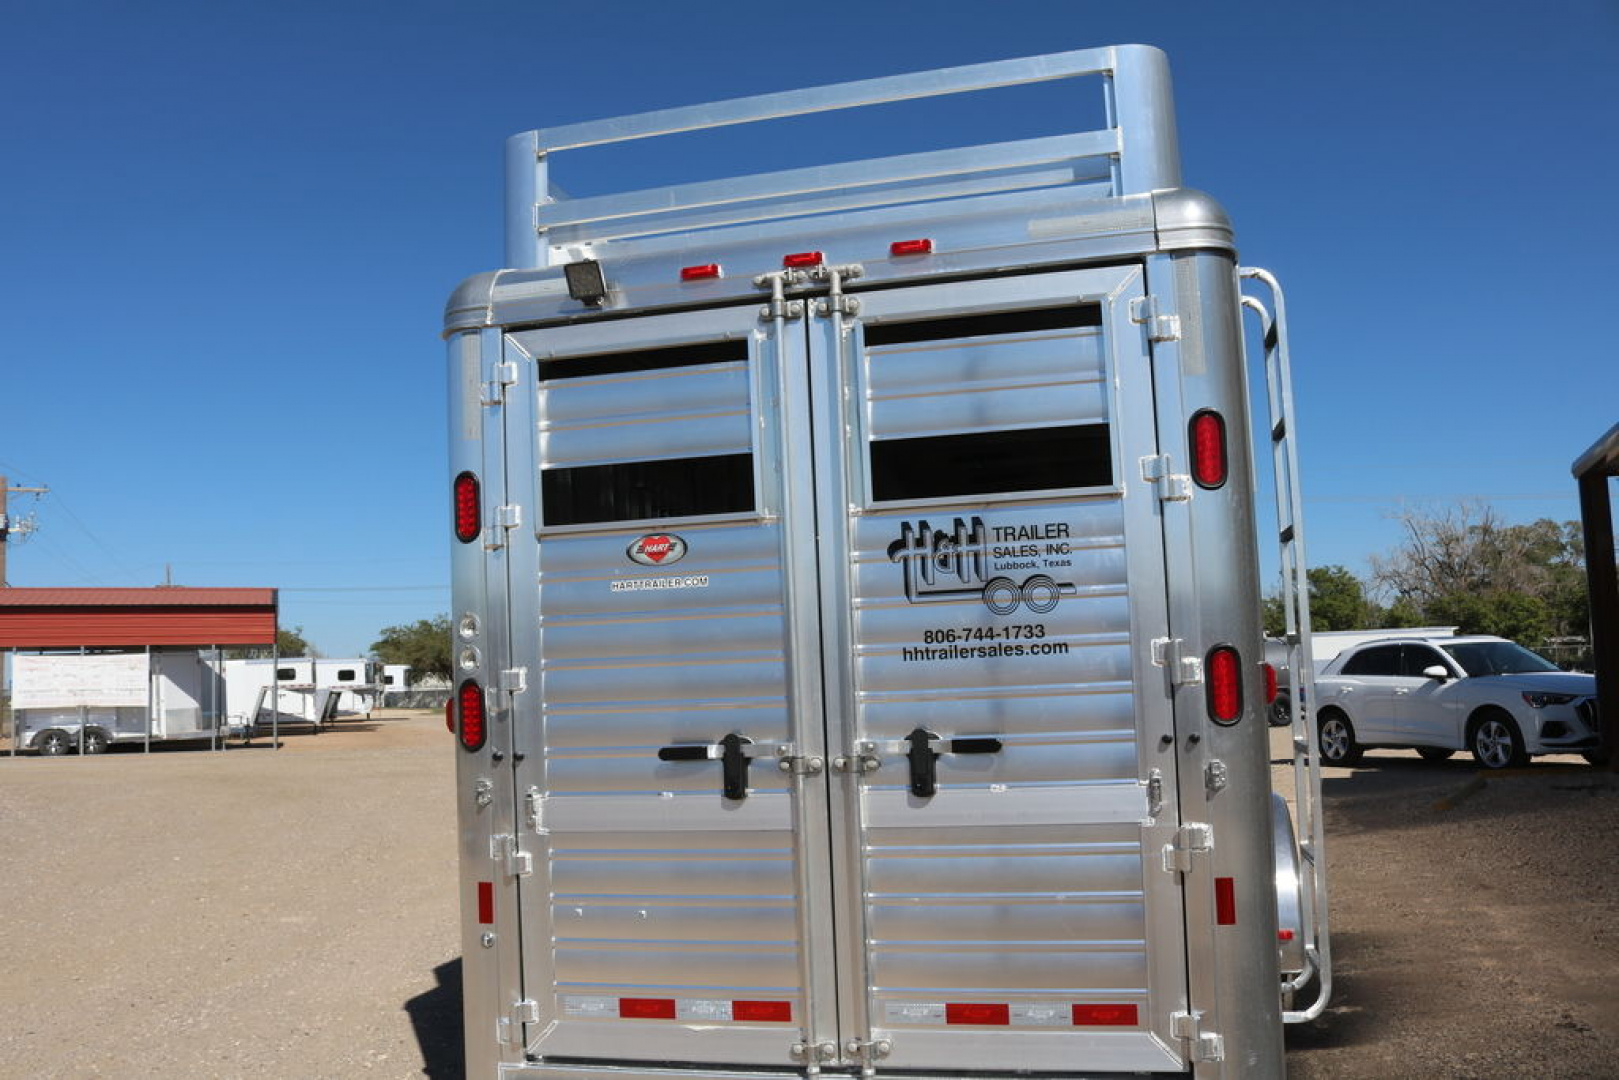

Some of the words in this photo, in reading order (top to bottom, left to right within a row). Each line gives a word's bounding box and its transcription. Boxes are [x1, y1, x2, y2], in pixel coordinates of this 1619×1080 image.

[992, 523, 1070, 542] TRAILER
[644, 543, 670, 553] HART
[992, 546, 1041, 559] SALES,
[1046, 543, 1073, 556] INC.
[994, 561, 1039, 571] Lubbock,
[1043, 559, 1072, 568] Texas
[924, 625, 1045, 644] 806-744-1733
[902, 641, 1069, 661] hhtrailersales.com
